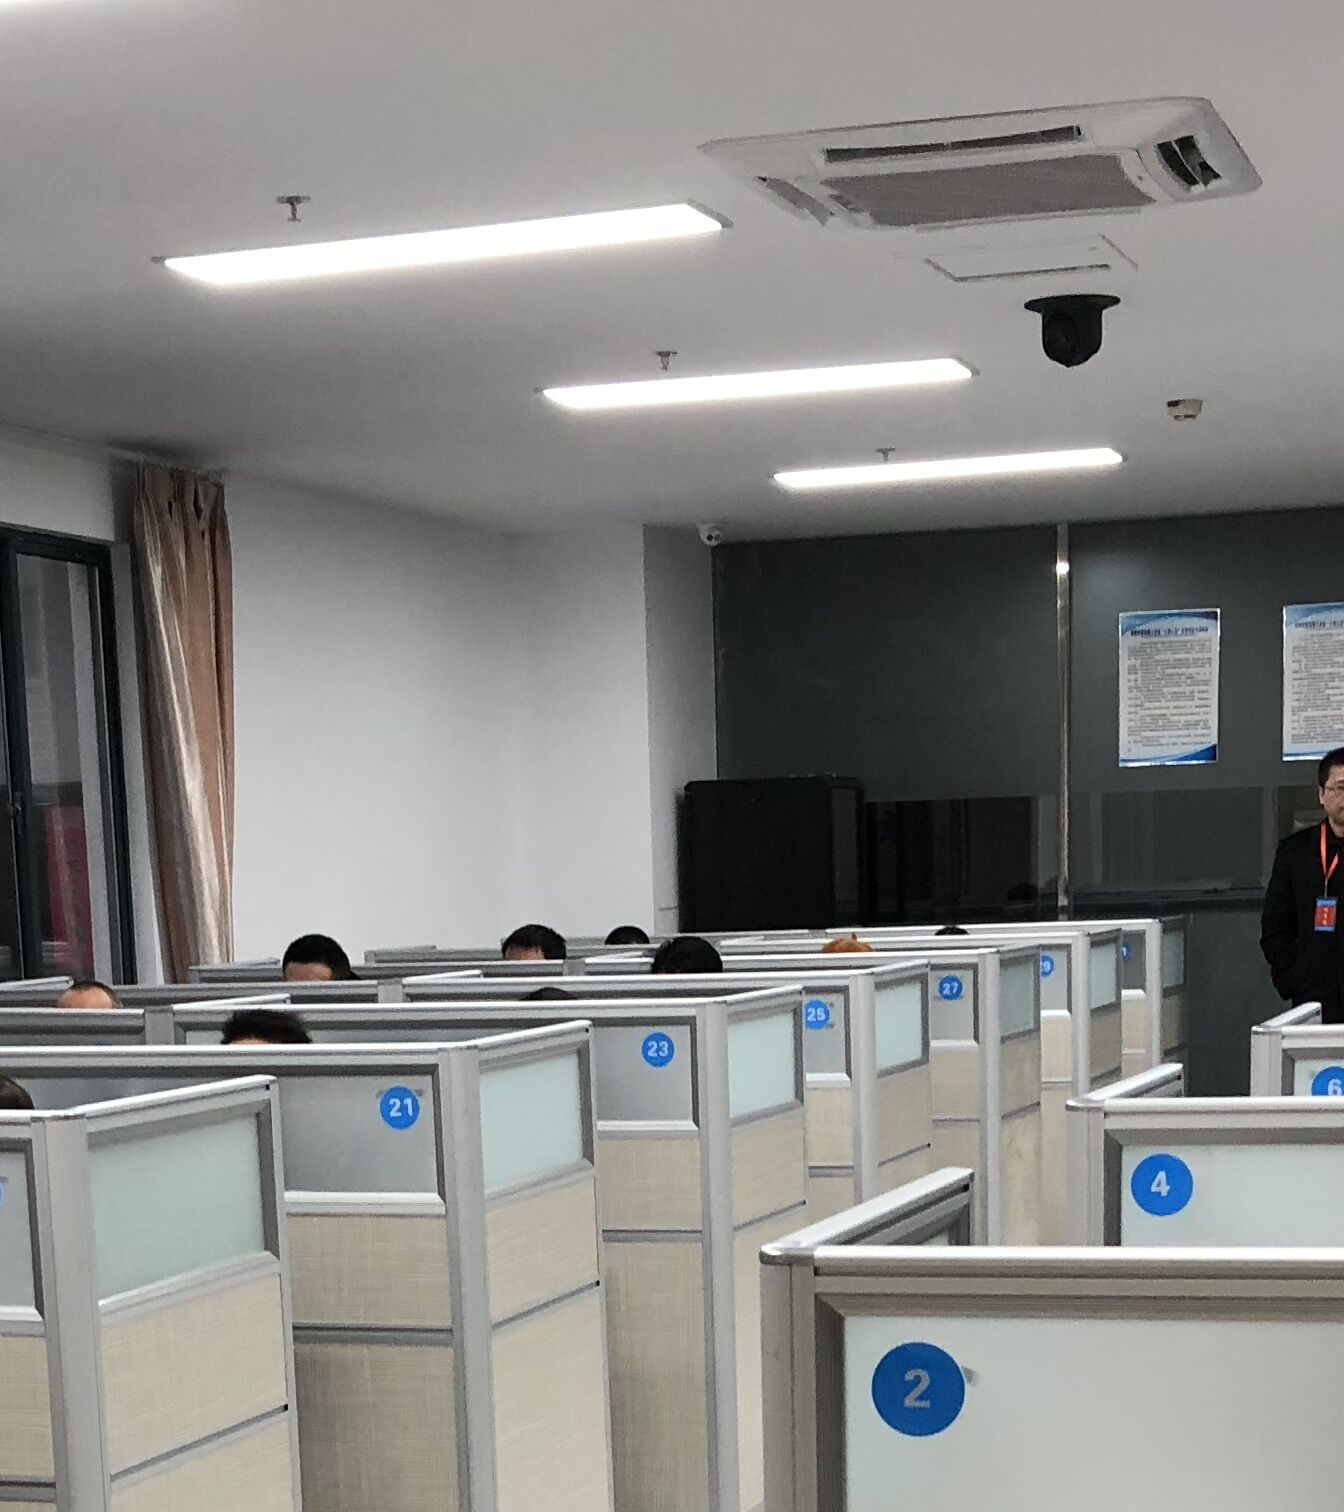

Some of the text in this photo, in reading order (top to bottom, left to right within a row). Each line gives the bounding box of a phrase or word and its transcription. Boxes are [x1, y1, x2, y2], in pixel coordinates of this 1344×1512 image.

[941, 982, 959, 995] 27
[807, 1007, 826, 1022] 25
[647, 1041, 670, 1058] 23
[1327, 1078, 1343, 1096] 6
[388, 1097, 414, 1118] 21
[1149, 1169, 1171, 1198] 4
[903, 1367, 931, 1409] 2
